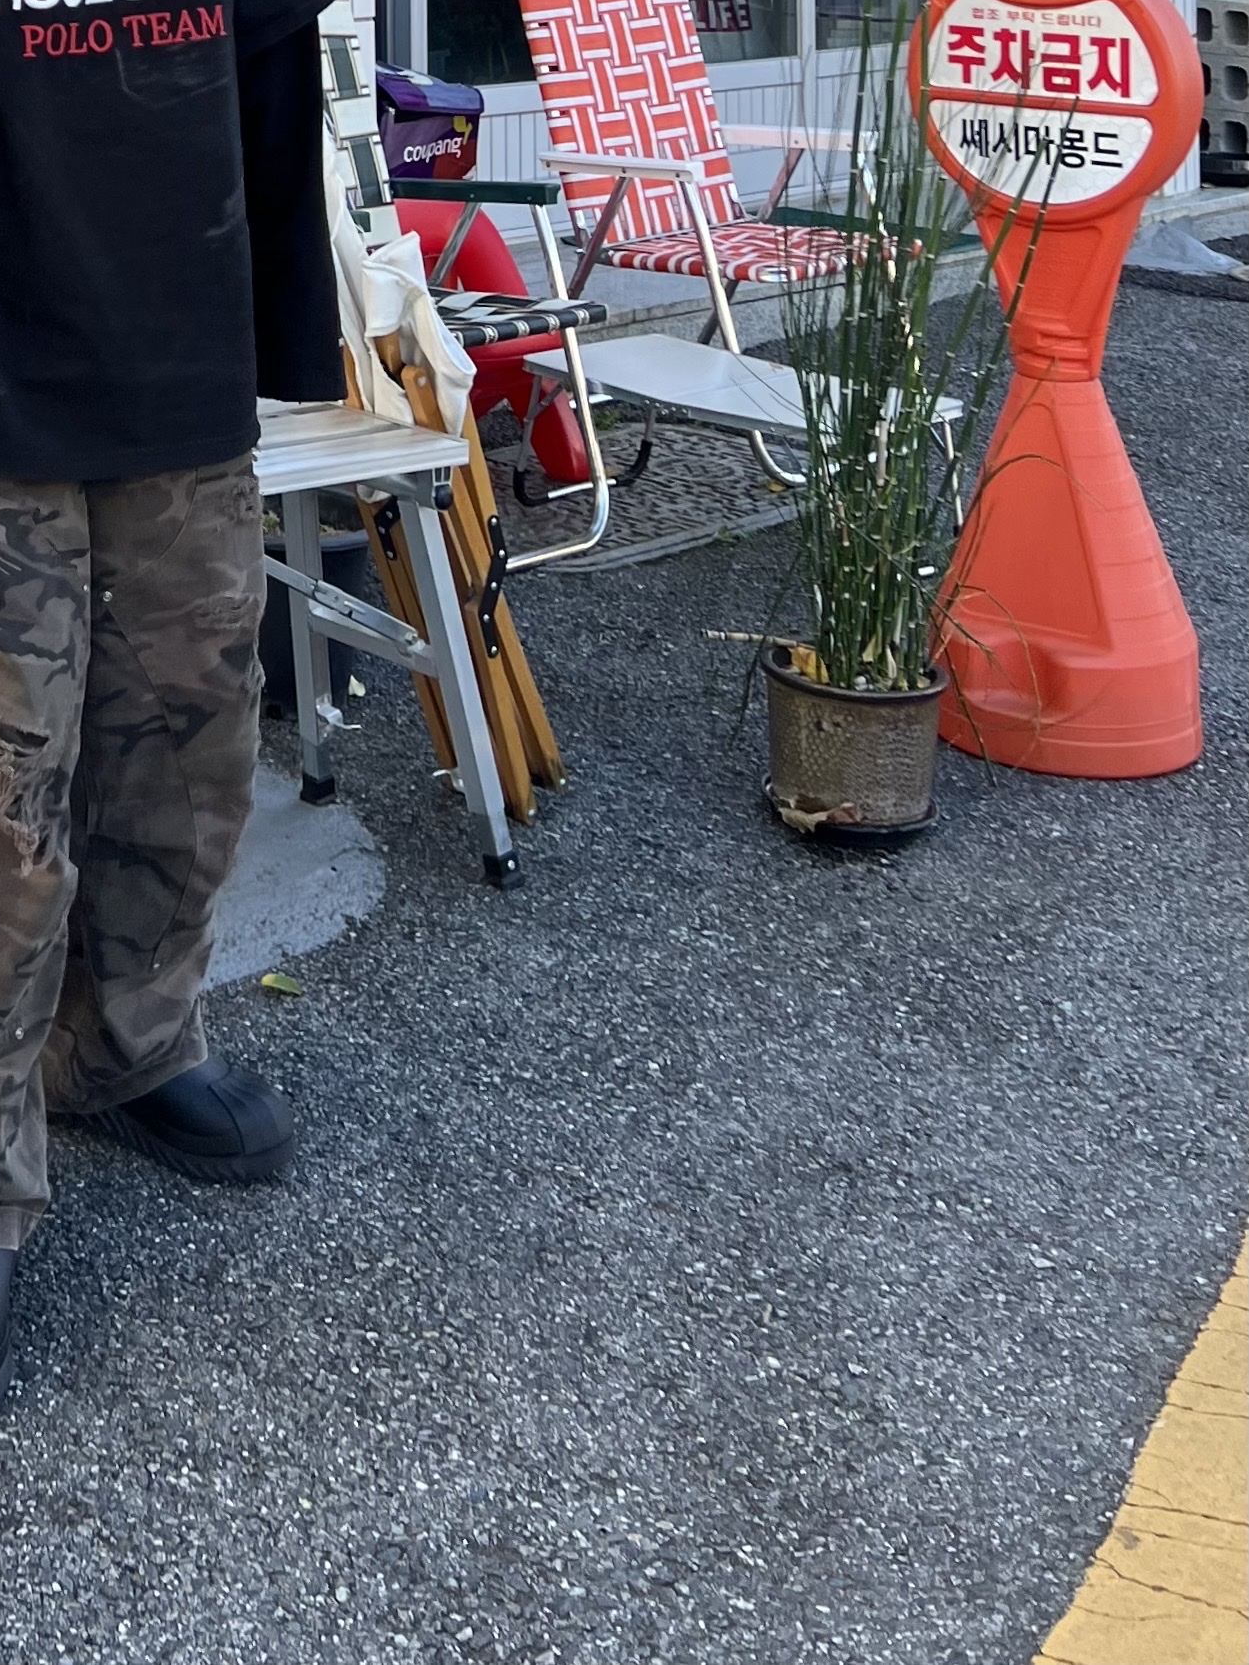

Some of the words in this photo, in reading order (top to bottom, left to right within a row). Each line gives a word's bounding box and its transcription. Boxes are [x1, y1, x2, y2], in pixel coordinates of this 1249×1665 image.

[21, 20, 114, 59] POLO
[122, 4, 227, 48] TEAM
[971, 6, 1000, 20] 협조
[1007, 10, 1035, 24] 부탁
[1040, 12, 1102, 28] 드립니다
[947, 25, 1131, 99] 주차금지
[403, 136, 463, 164] coupang
[959, 118, 1124, 169] 쎄시마몽드
